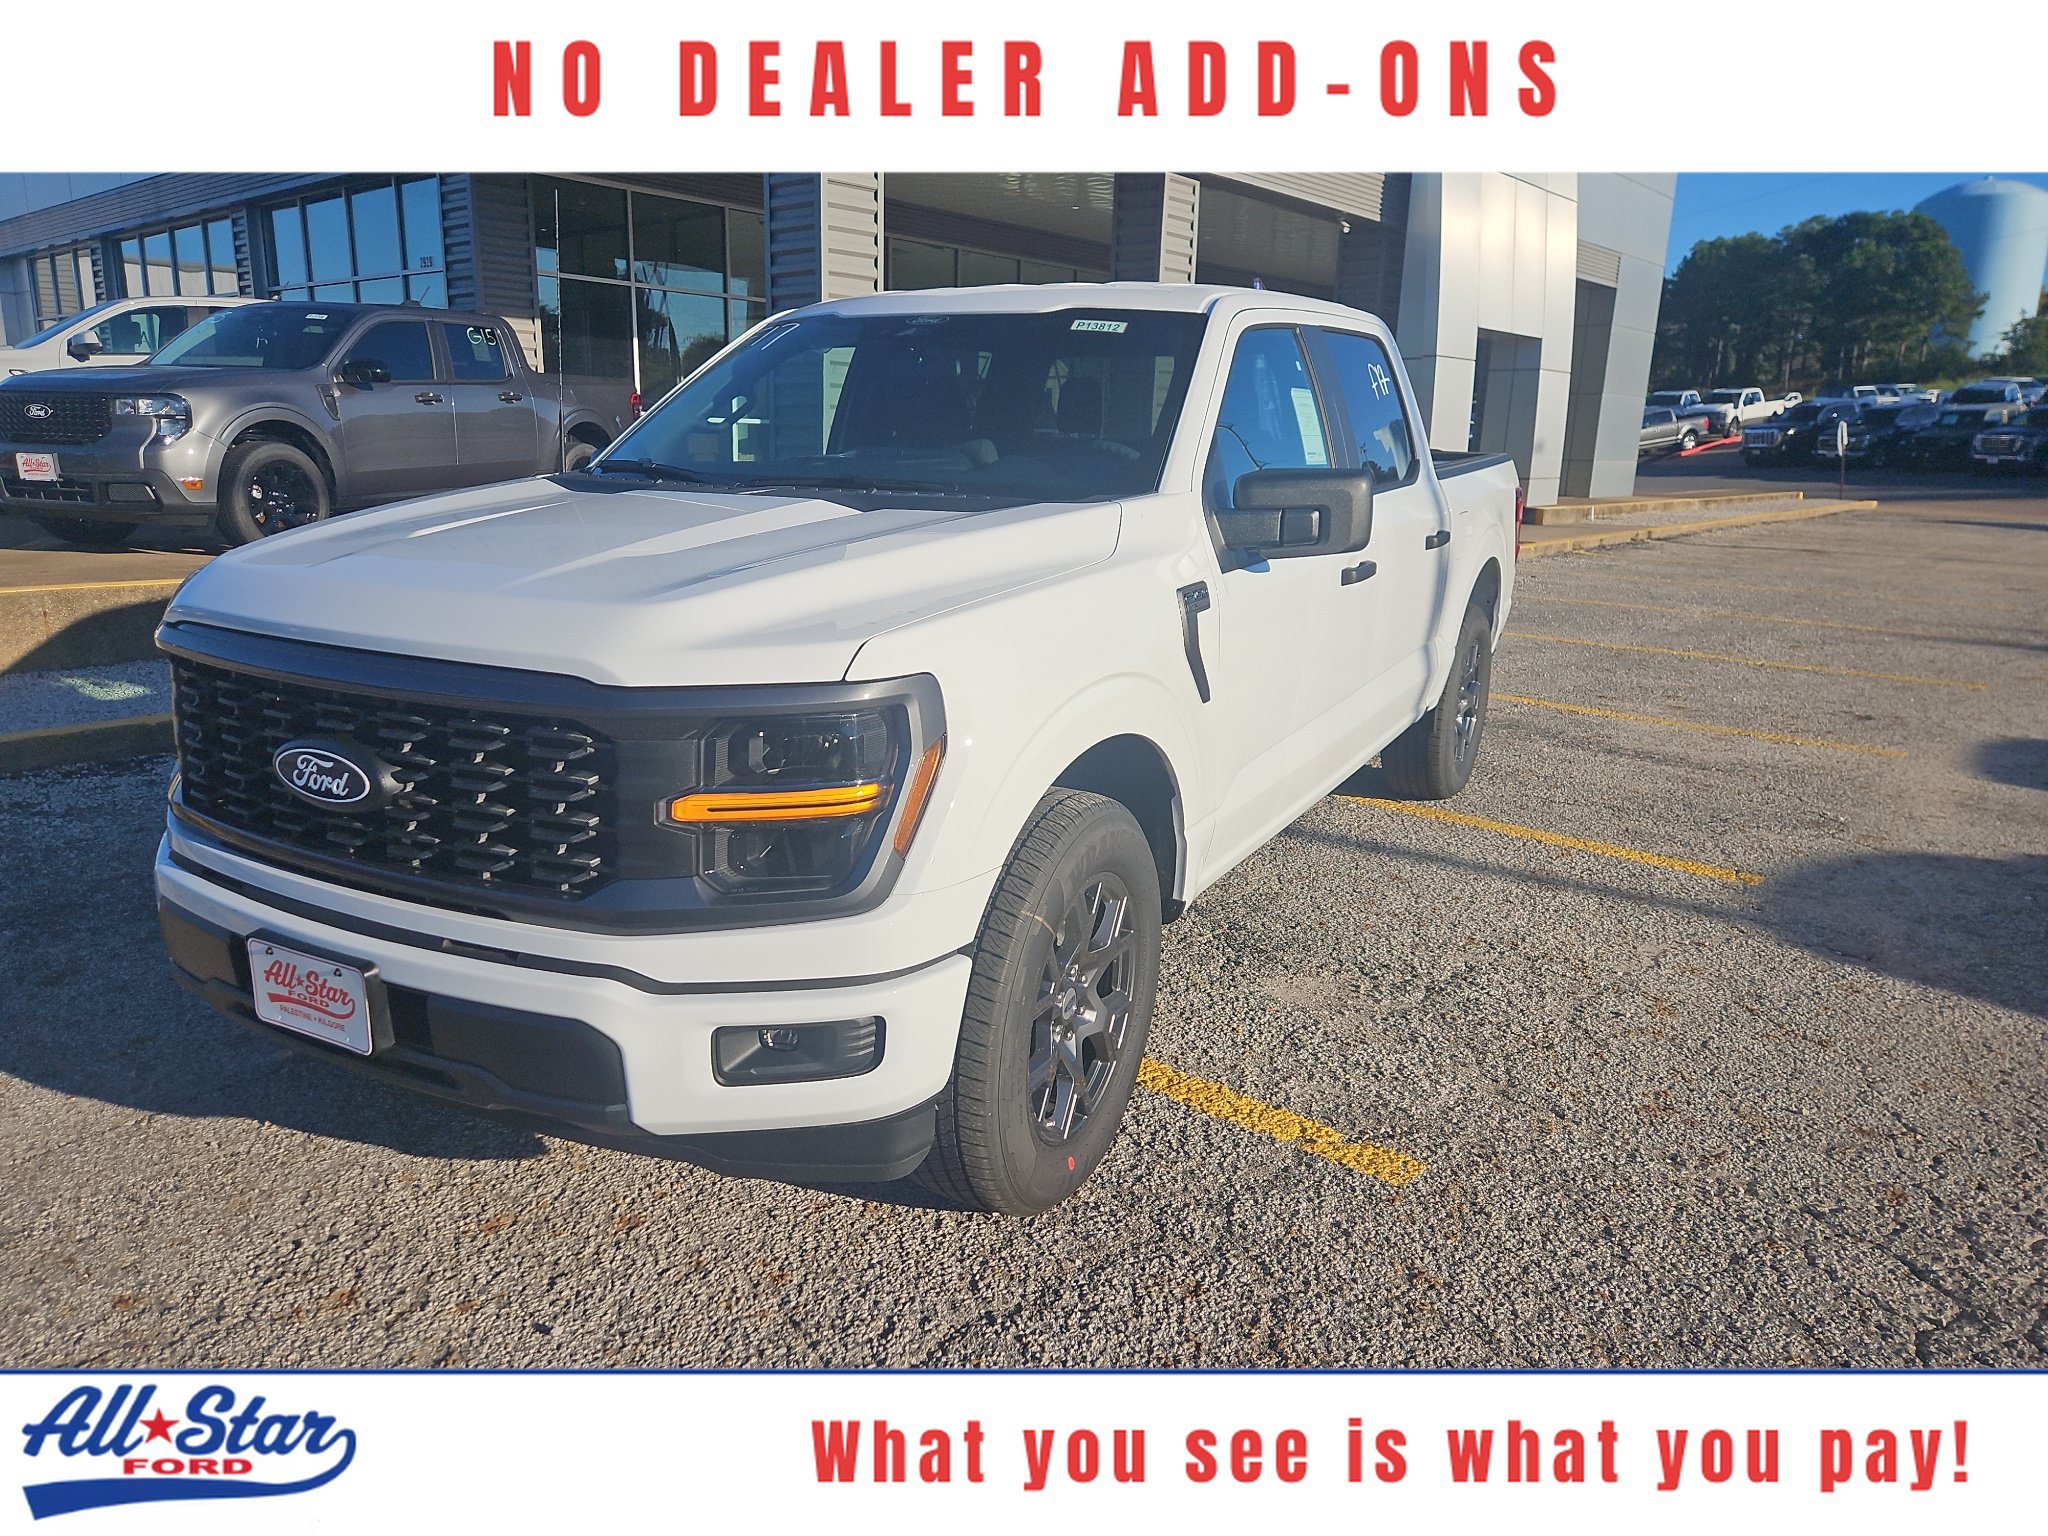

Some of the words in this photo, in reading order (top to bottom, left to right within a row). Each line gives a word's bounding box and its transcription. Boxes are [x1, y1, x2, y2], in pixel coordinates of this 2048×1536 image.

[1076, 321, 1120, 331] P13812
[466, 327, 497, 346] G15
[22, 458, 33, 467] All
[35, 458, 49, 467] Star
[293, 754, 349, 796] Ford
[264, 960, 297, 989] All
[305, 970, 350, 1006] Star
[287, 990, 330, 1008] FORD
[279, 1004, 313, 1020] PALESTINE
[318, 1017, 345, 1032] KILGORE
